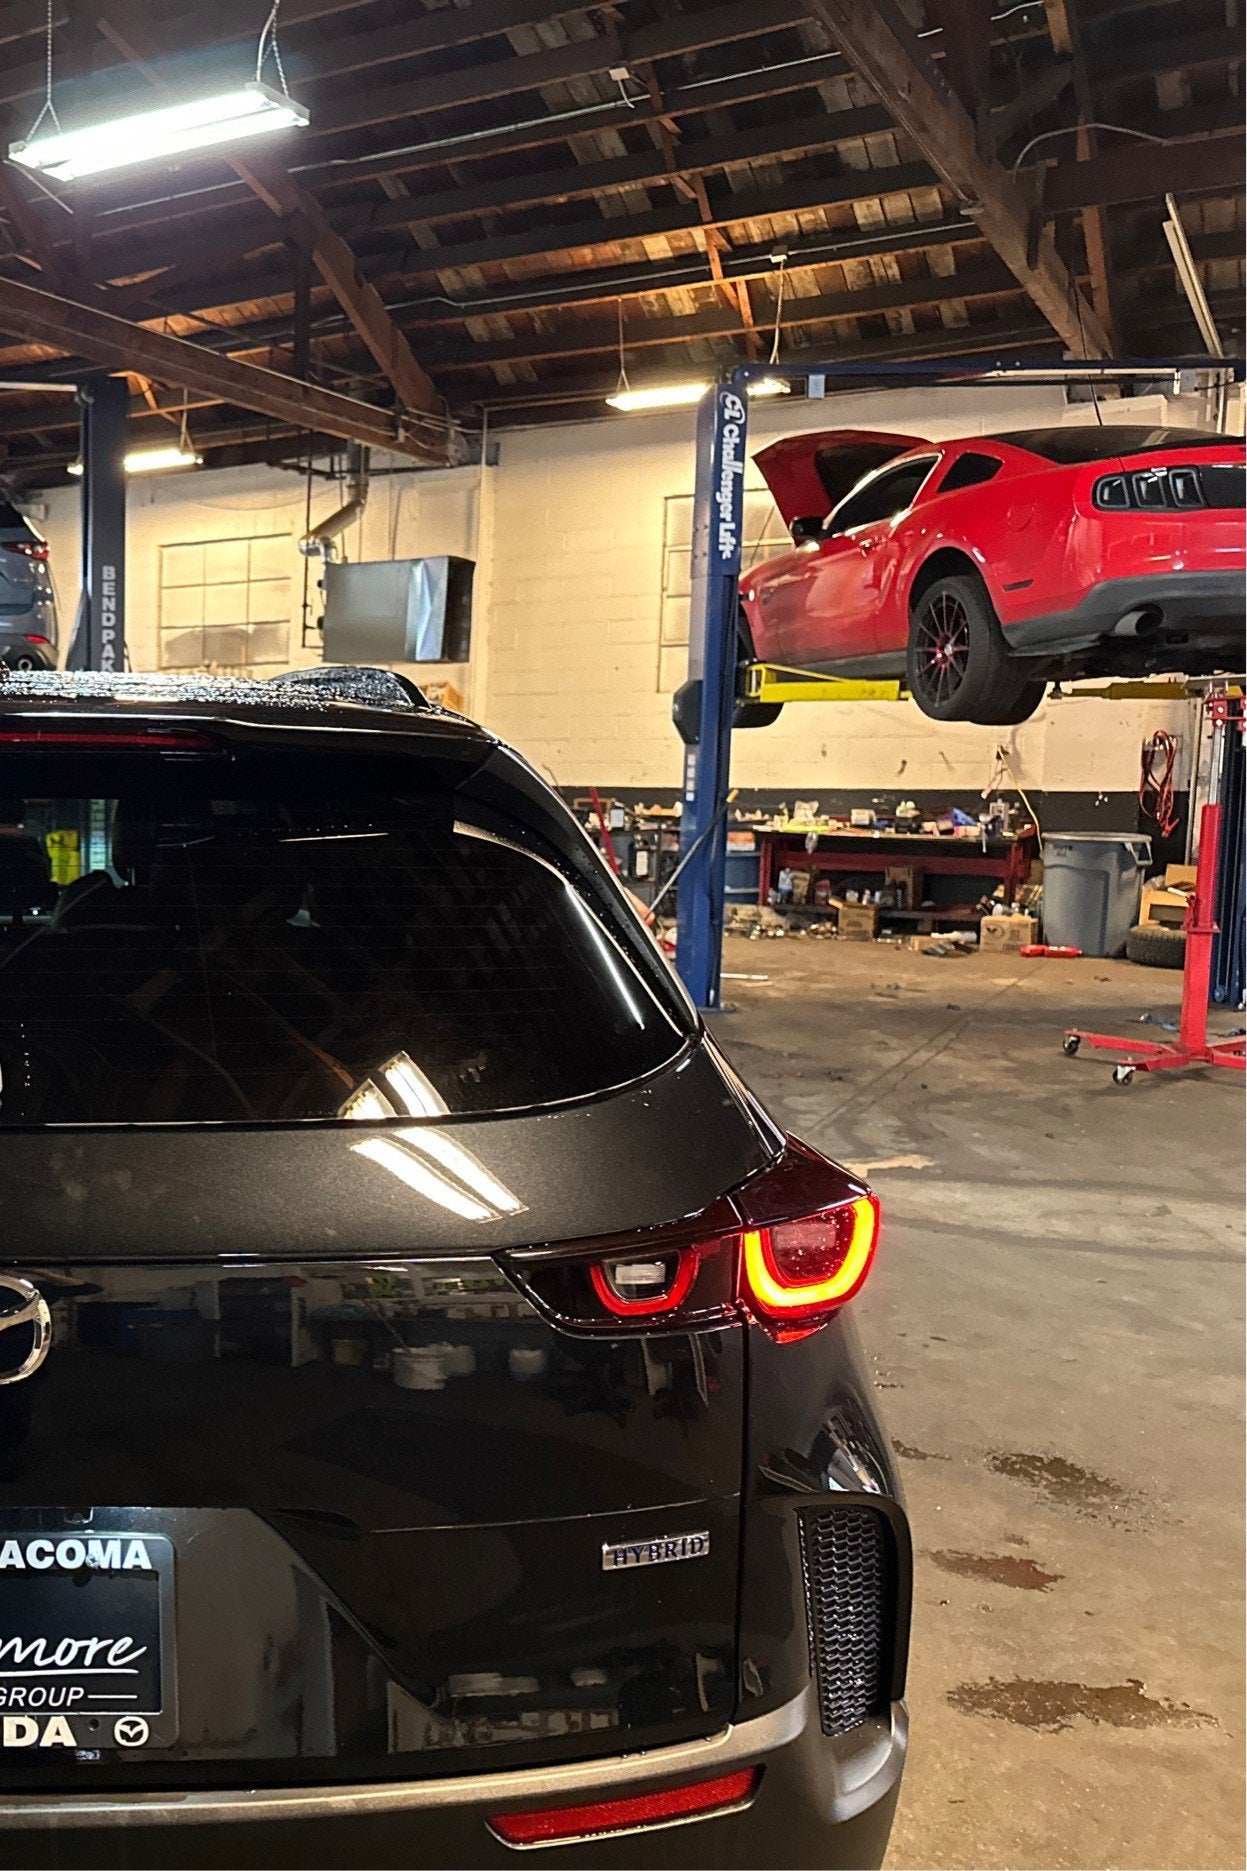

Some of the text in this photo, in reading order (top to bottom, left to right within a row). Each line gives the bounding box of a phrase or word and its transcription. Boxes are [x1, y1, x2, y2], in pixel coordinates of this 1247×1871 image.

[716, 423, 743, 521] Challenger
[101, 565, 116, 672] BENDPAK
[613, 1537, 706, 1566] HYBRID
